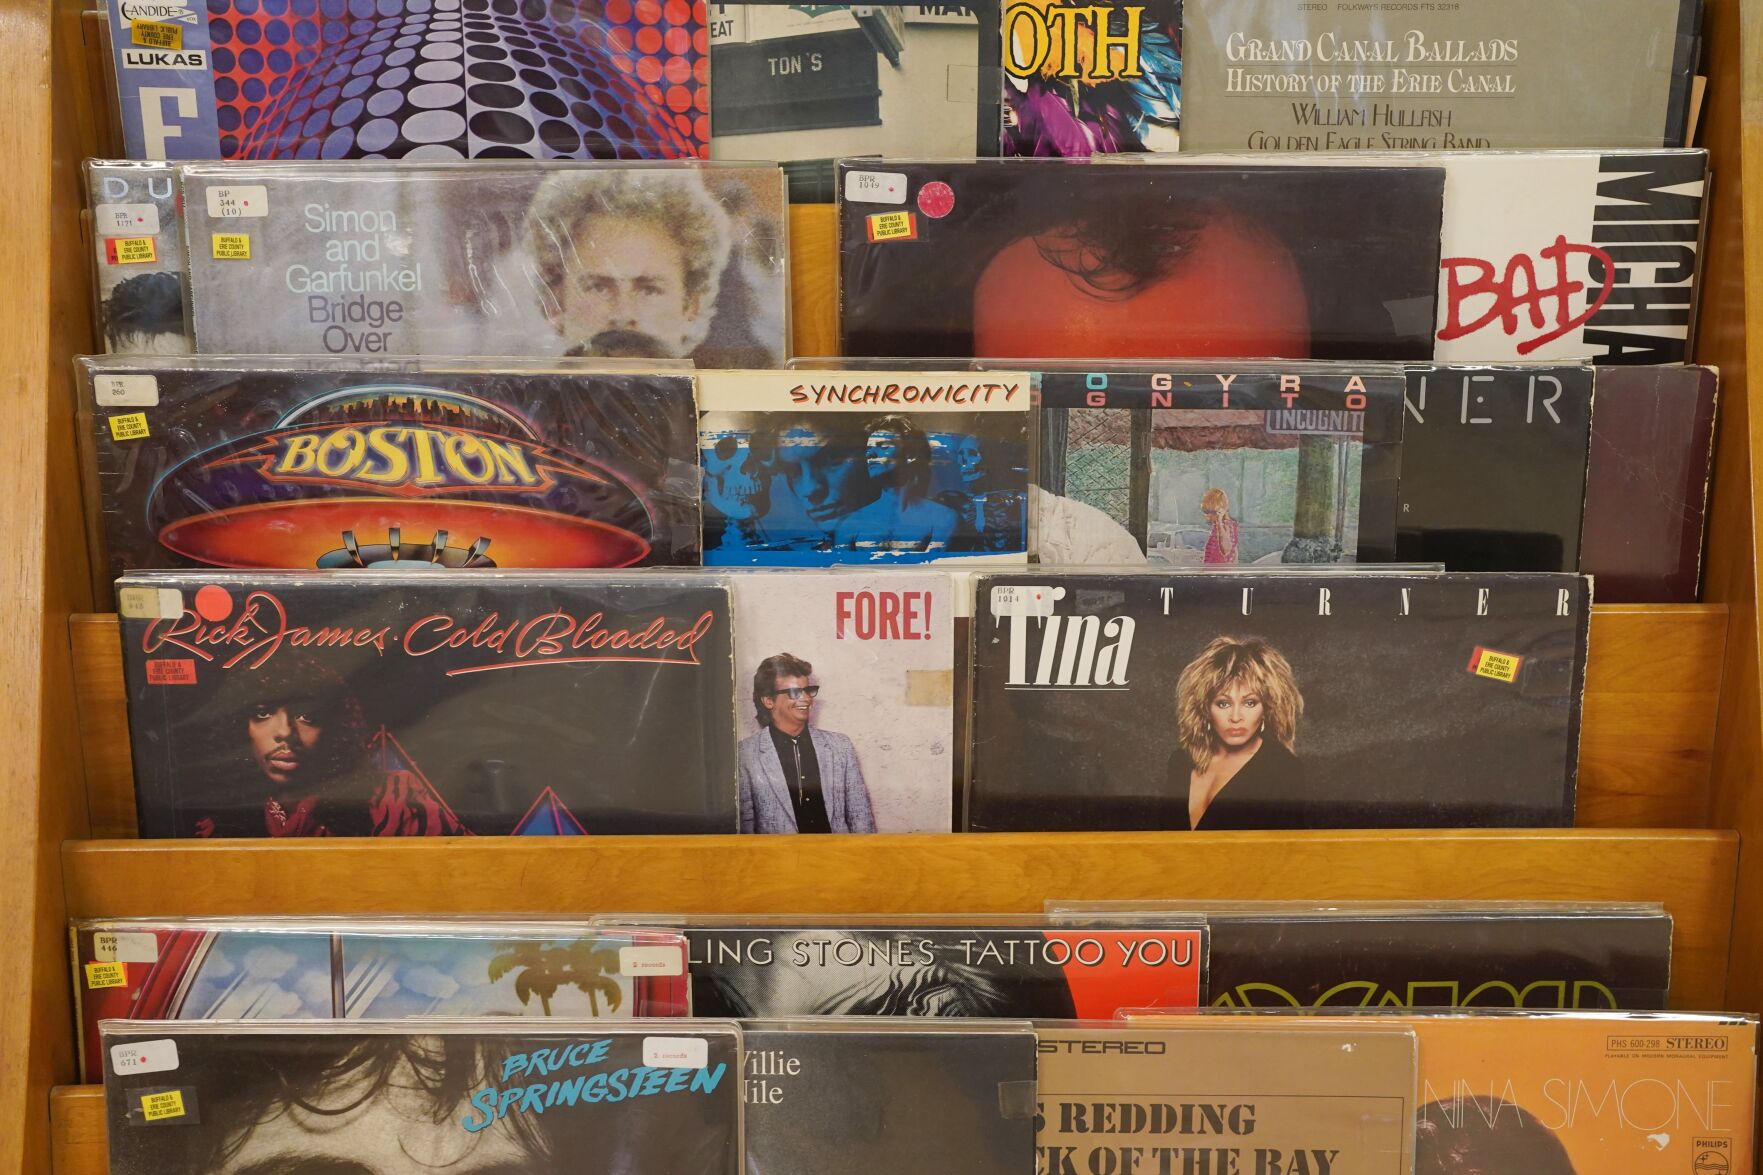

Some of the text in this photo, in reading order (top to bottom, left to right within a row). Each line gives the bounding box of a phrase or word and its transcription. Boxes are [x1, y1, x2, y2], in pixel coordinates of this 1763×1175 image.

[1004, 5, 1146, 77] OTH
[1226, 30, 1518, 62] GRAND CANAL BALLADS
[127, 53, 202, 66] LUKAS
[1226, 68, 1314, 93] HISTORY
[1392, 68, 1442, 93] ERIE
[1447, 68, 1516, 94] CANAL
[221, 208, 242, 216] (10)
[304, 204, 396, 233] Simon
[326, 234, 380, 262] and
[286, 263, 422, 293] Garfunkel
[1437, 234, 1615, 356] BAD
[308, 294, 404, 328] Bridge
[323, 325, 392, 354] Over
[788, 383, 1020, 406] SYNCHRONICITY
[1275, 410, 1364, 432] INCOGNIT
[278, 425, 538, 485] BOSTON
[836, 591, 932, 640] FORE!
[1160, 587, 1570, 616] TURNER
[143, 603, 266, 662] Rick
[403, 612, 520, 657] Cold
[515, 606, 714, 664] Blooded
[995, 587, 1136, 686] Tina
[1489, 656, 1506, 664] BUFFALO
[1494, 663, 1510, 671] COUNTY
[1494, 670, 1511, 679] LIBRARY
[688, 939, 1193, 967] LING STONES TATTOO YOU
[1038, 1040, 1166, 1054] STEREO
[1666, 1038, 1726, 1049] STEREO
[502, 1039, 613, 1082] BRUCE
[462, 1062, 726, 1133] SPRINGSTEEN
[1424, 1078, 1733, 1131] NINA SIMONE
[1059, 1103, 1256, 1136] REDDING
[1088, 1146, 1146, 1175] OF
[1152, 1148, 1241, 1175] THE
[1263, 1148, 1340, 1175] BAY
